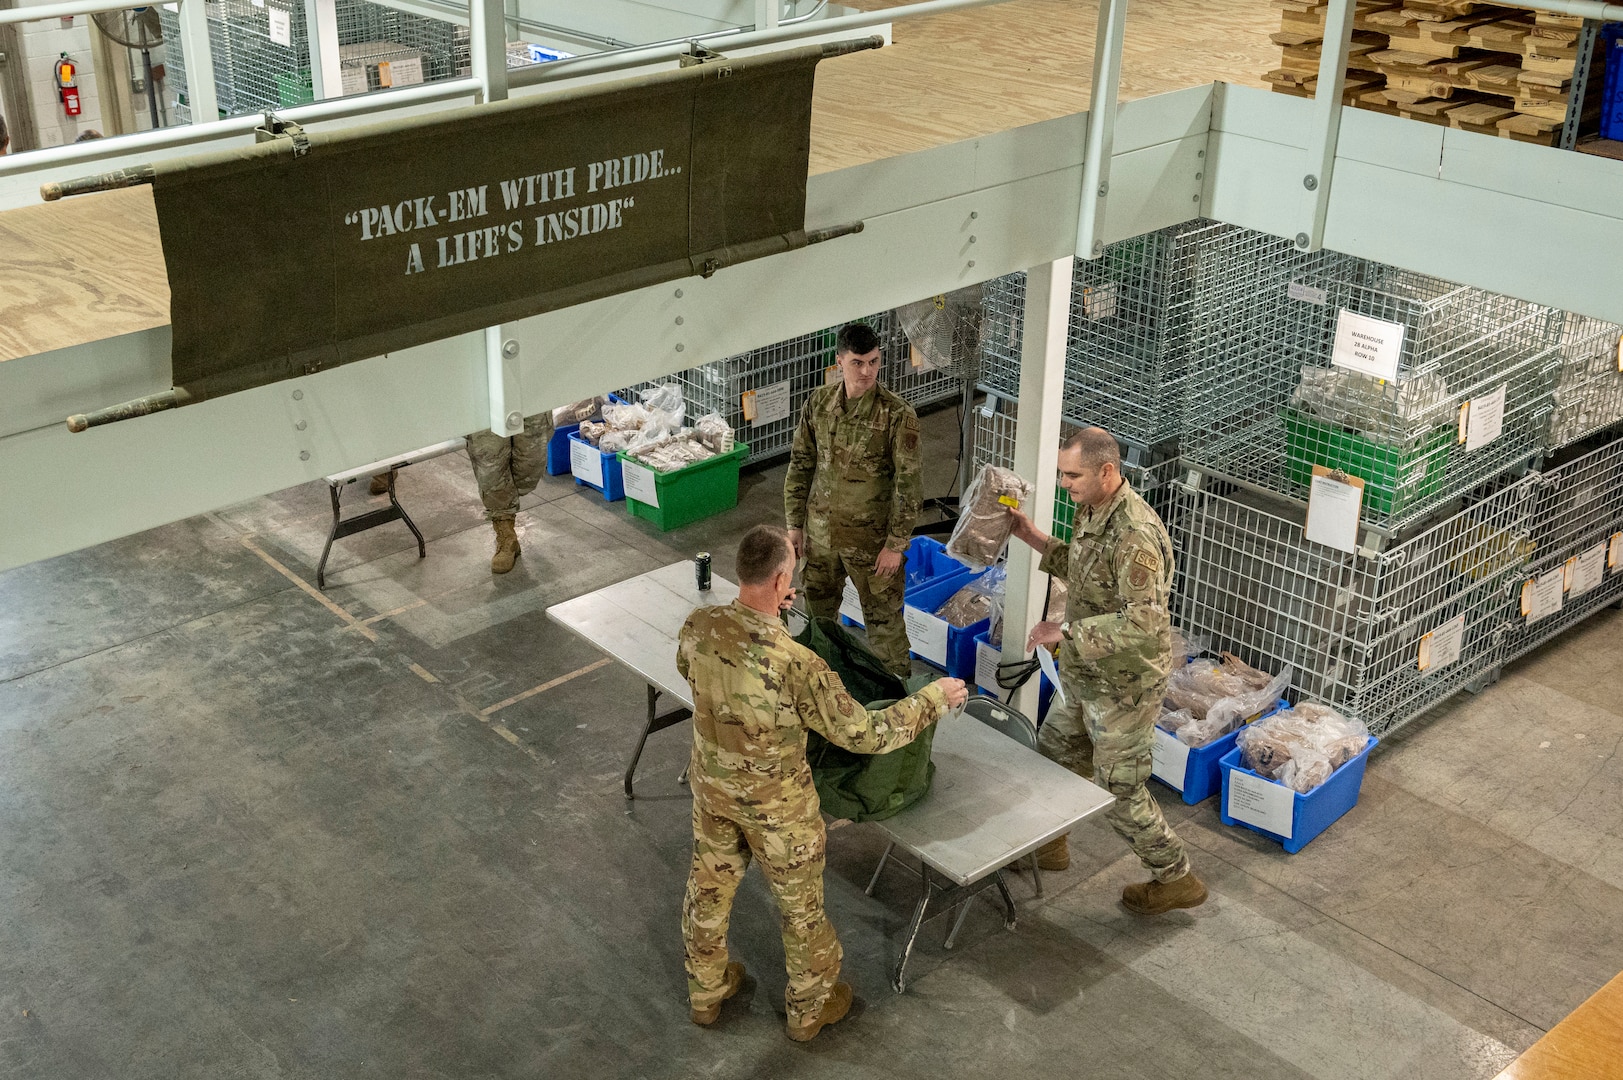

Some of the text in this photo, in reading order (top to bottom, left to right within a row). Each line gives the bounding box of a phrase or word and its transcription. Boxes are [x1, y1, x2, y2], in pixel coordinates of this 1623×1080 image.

[500, 167, 576, 211] WITH
[587, 149, 682, 193] PRIDE...
[405, 243, 425, 275] A
[1351, 331, 1384, 345] WAREHOUSE
[1361, 343, 1378, 352] ALPHA
[1354, 351, 1367, 359] ROW
[1138, 553, 1157, 568] SUP
